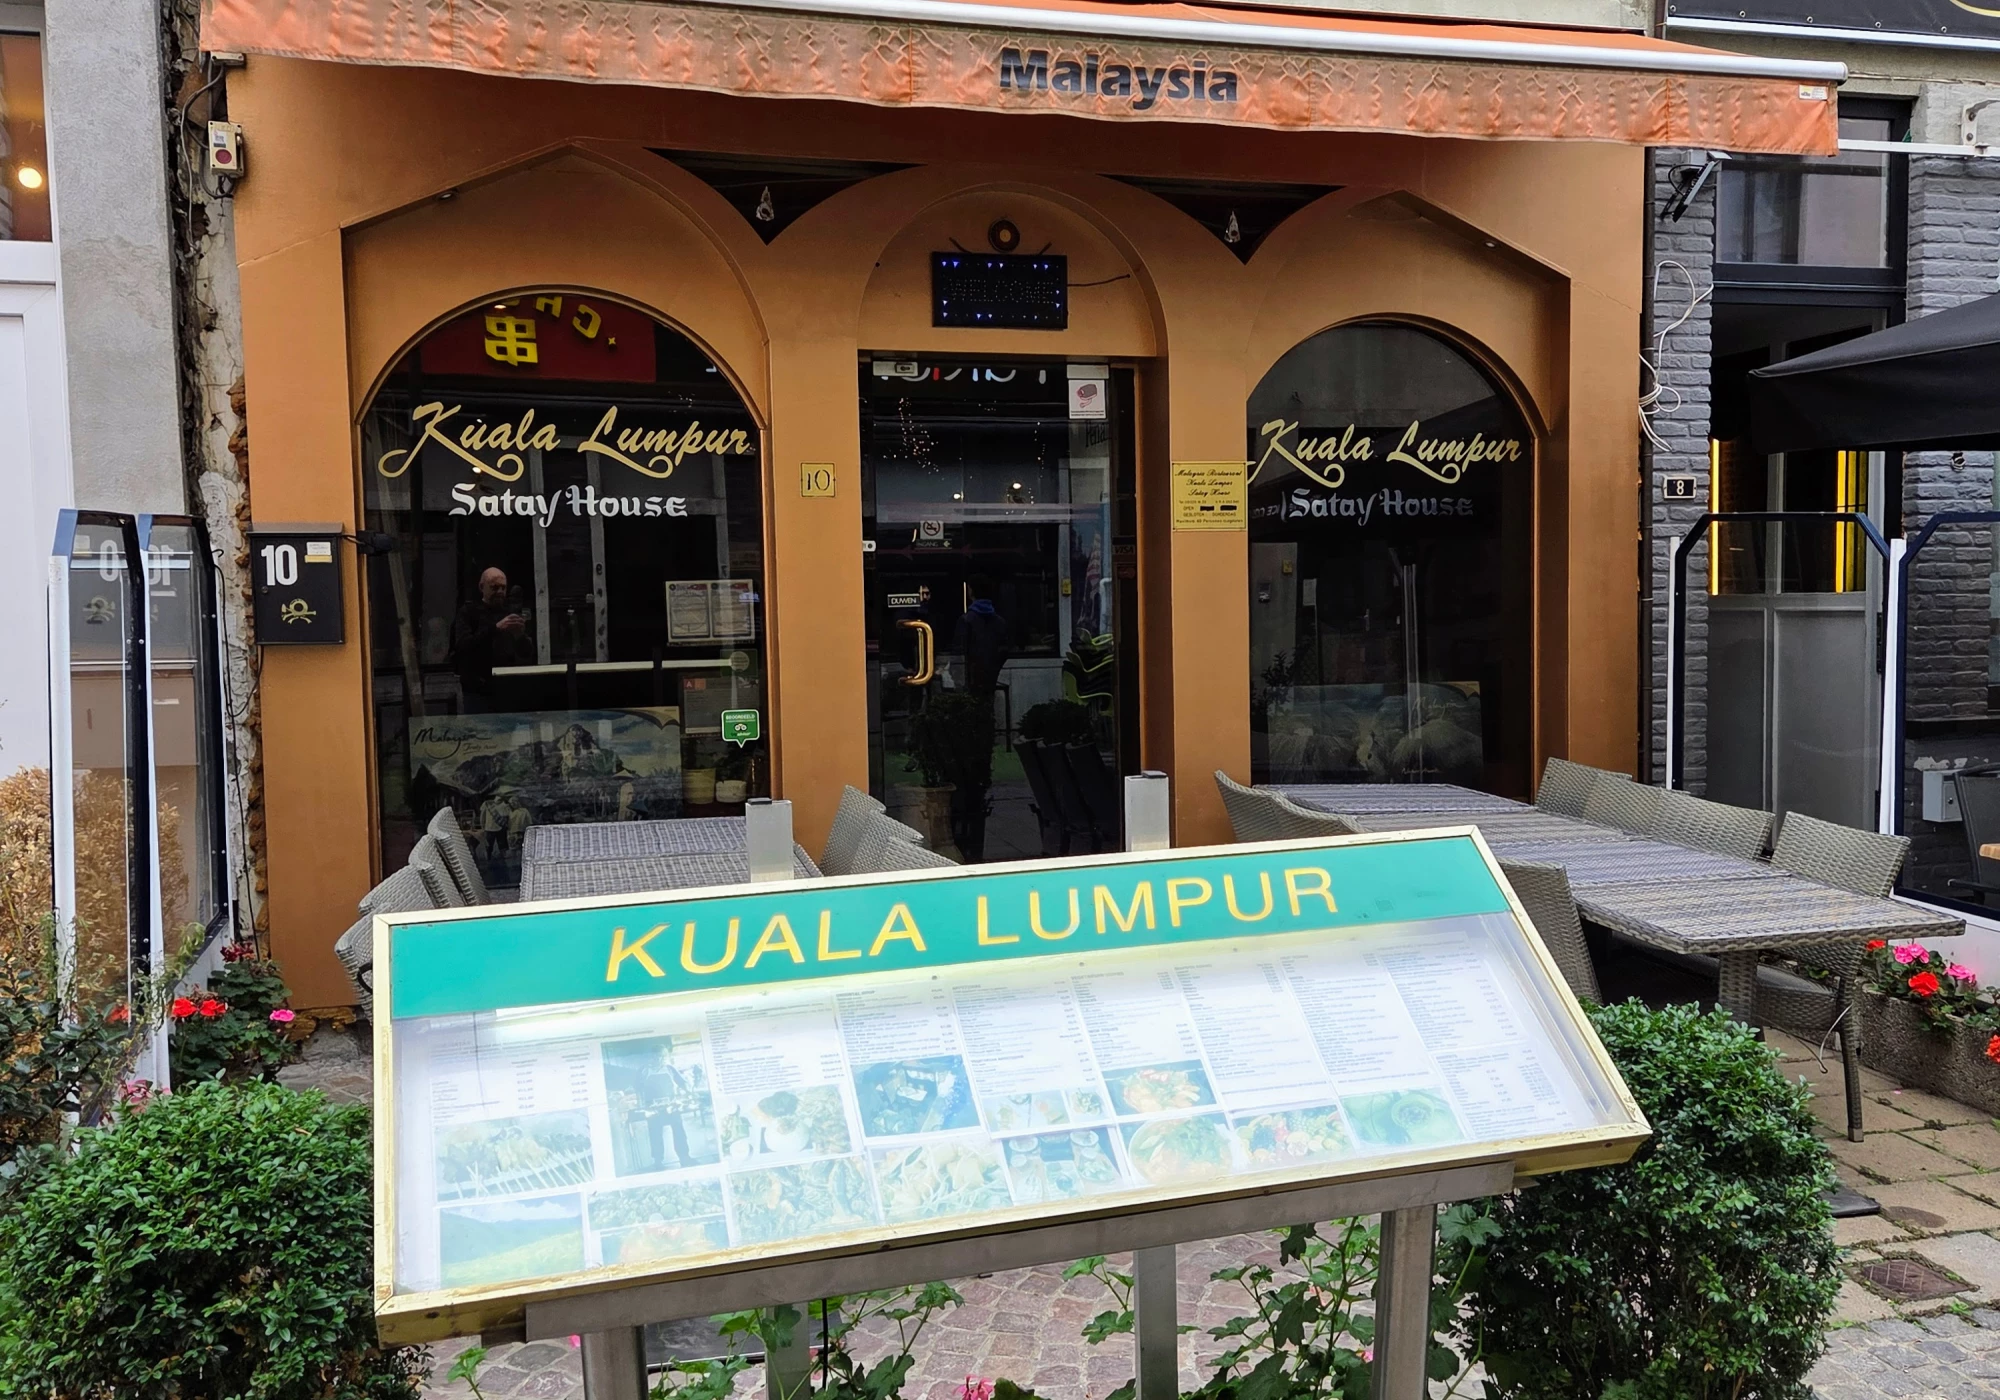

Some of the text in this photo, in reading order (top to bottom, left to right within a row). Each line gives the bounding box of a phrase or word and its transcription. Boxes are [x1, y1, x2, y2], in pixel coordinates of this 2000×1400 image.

[1000, 47, 1238, 110] Malaysia
[948, 279, 1054, 304] WELCOME
[378, 402, 750, 482] Kuala Lumpur
[1247, 419, 1522, 488] Kuala Lumpur
[807, 469, 831, 491] 10
[1207, 468, 1243, 477] Restaurant
[1208, 479, 1233, 487] Lumpur
[1676, 480, 1685, 496] 8
[449, 483, 688, 528] Satay House
[1188, 489, 1208, 497] Satay
[1289, 488, 1474, 526] Satay House
[261, 544, 298, 586] 10
[606, 866, 1339, 982] KUALA LUMPUR
